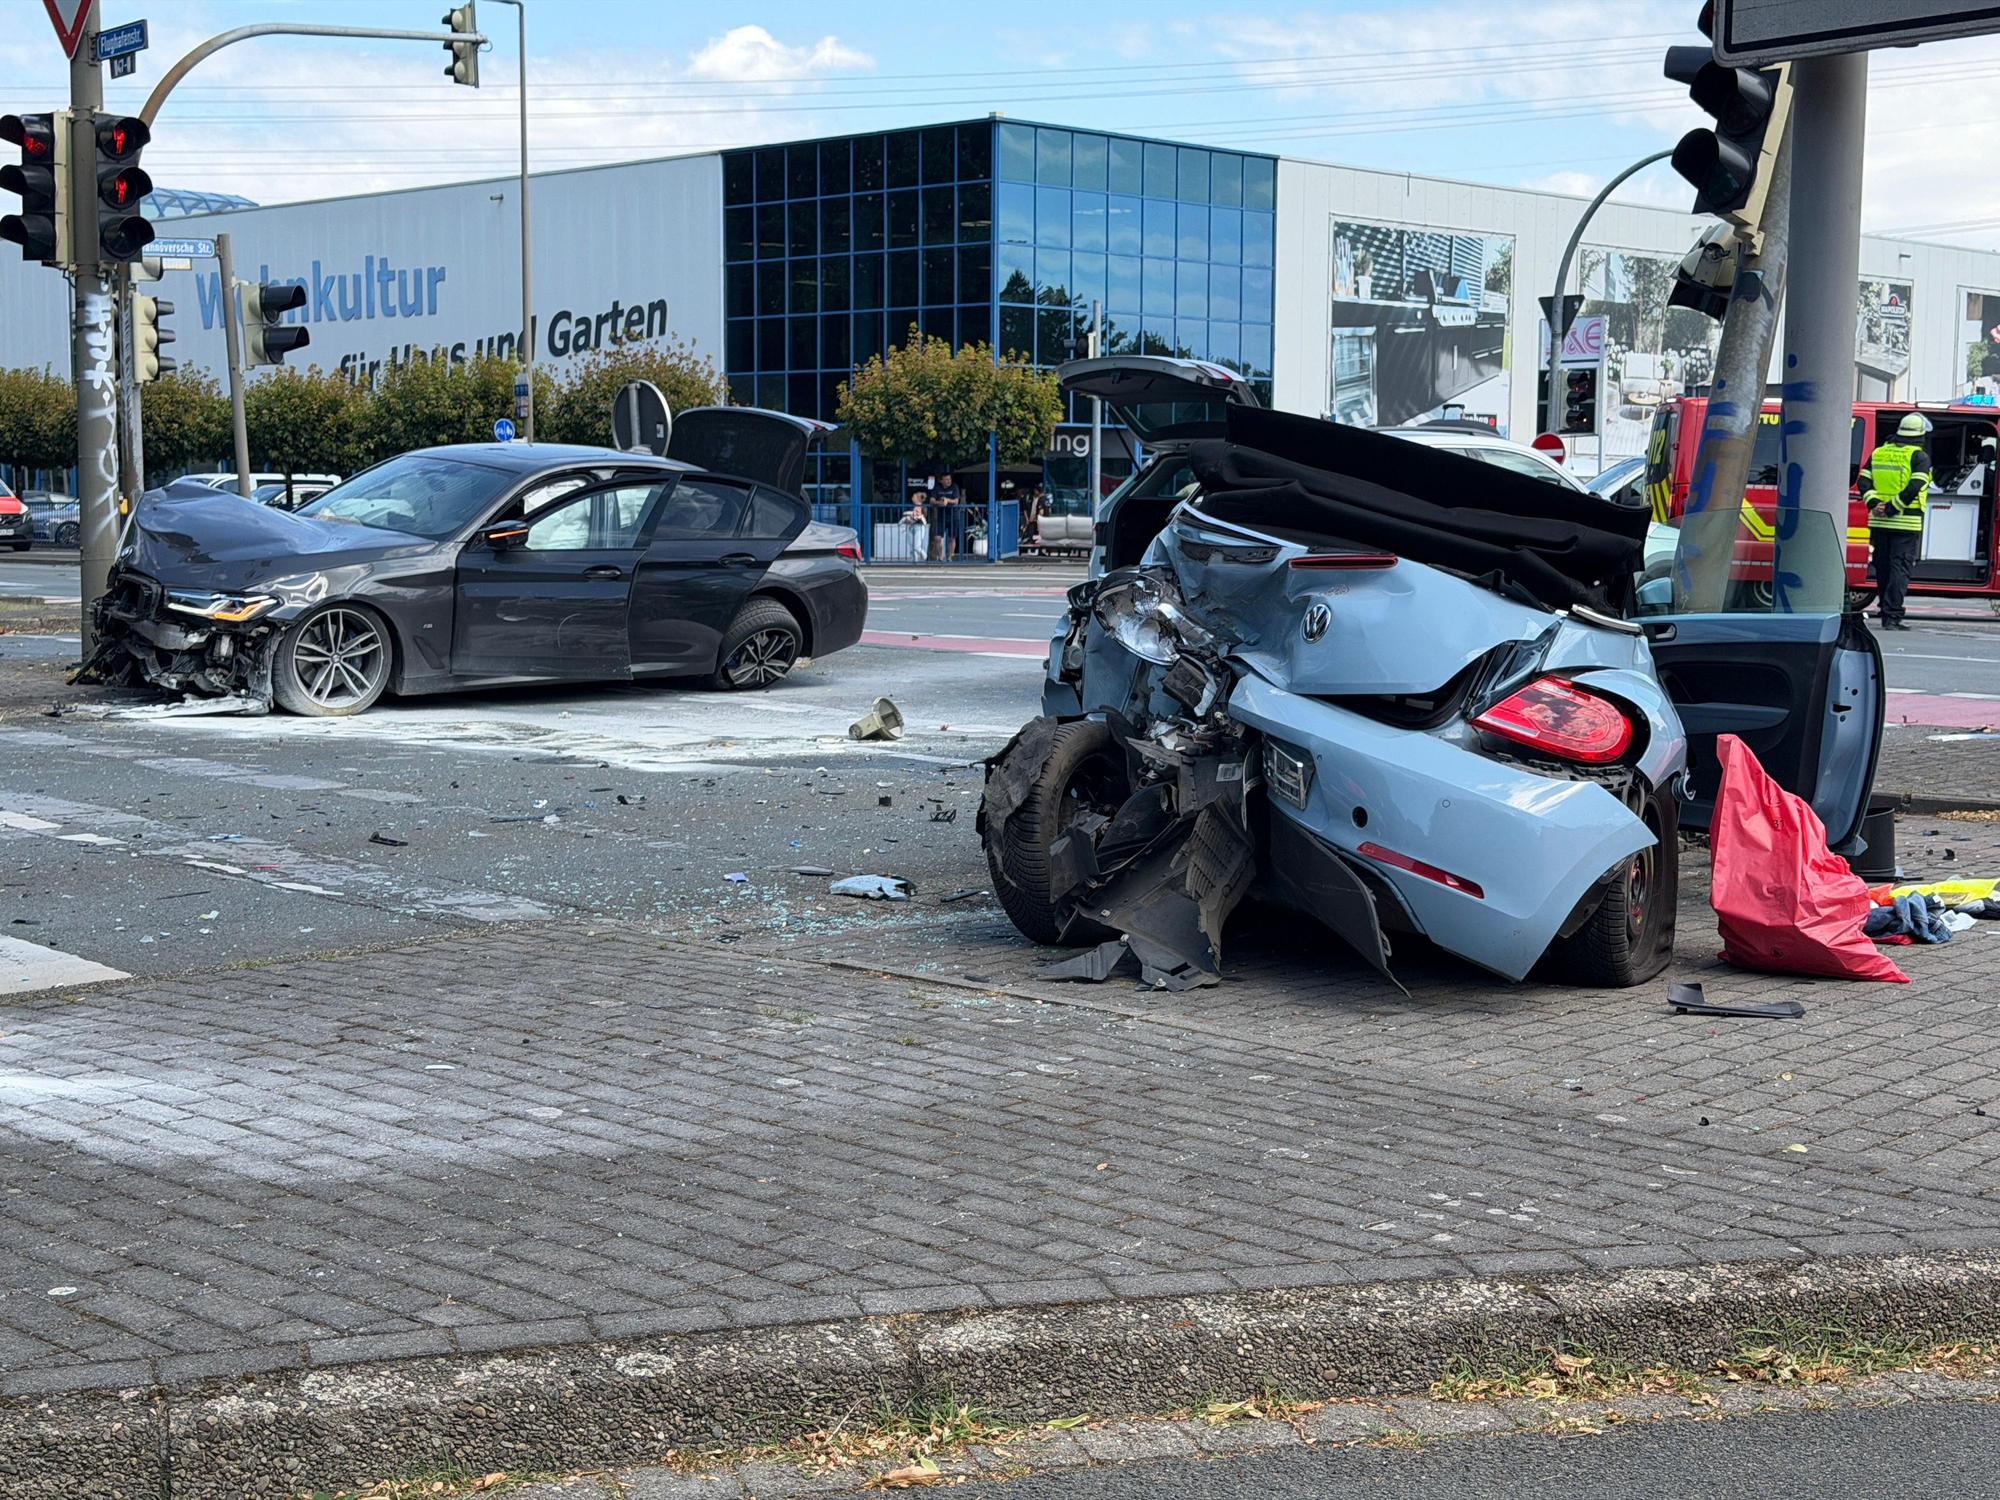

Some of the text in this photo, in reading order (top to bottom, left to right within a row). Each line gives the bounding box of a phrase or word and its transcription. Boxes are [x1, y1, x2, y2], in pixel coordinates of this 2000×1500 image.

[100, 28, 142, 54] Flughafenstr.
[198, 241, 212, 254] Str.
[196, 255, 446, 329] Wnkultur
[548, 298, 667, 358] Garten
